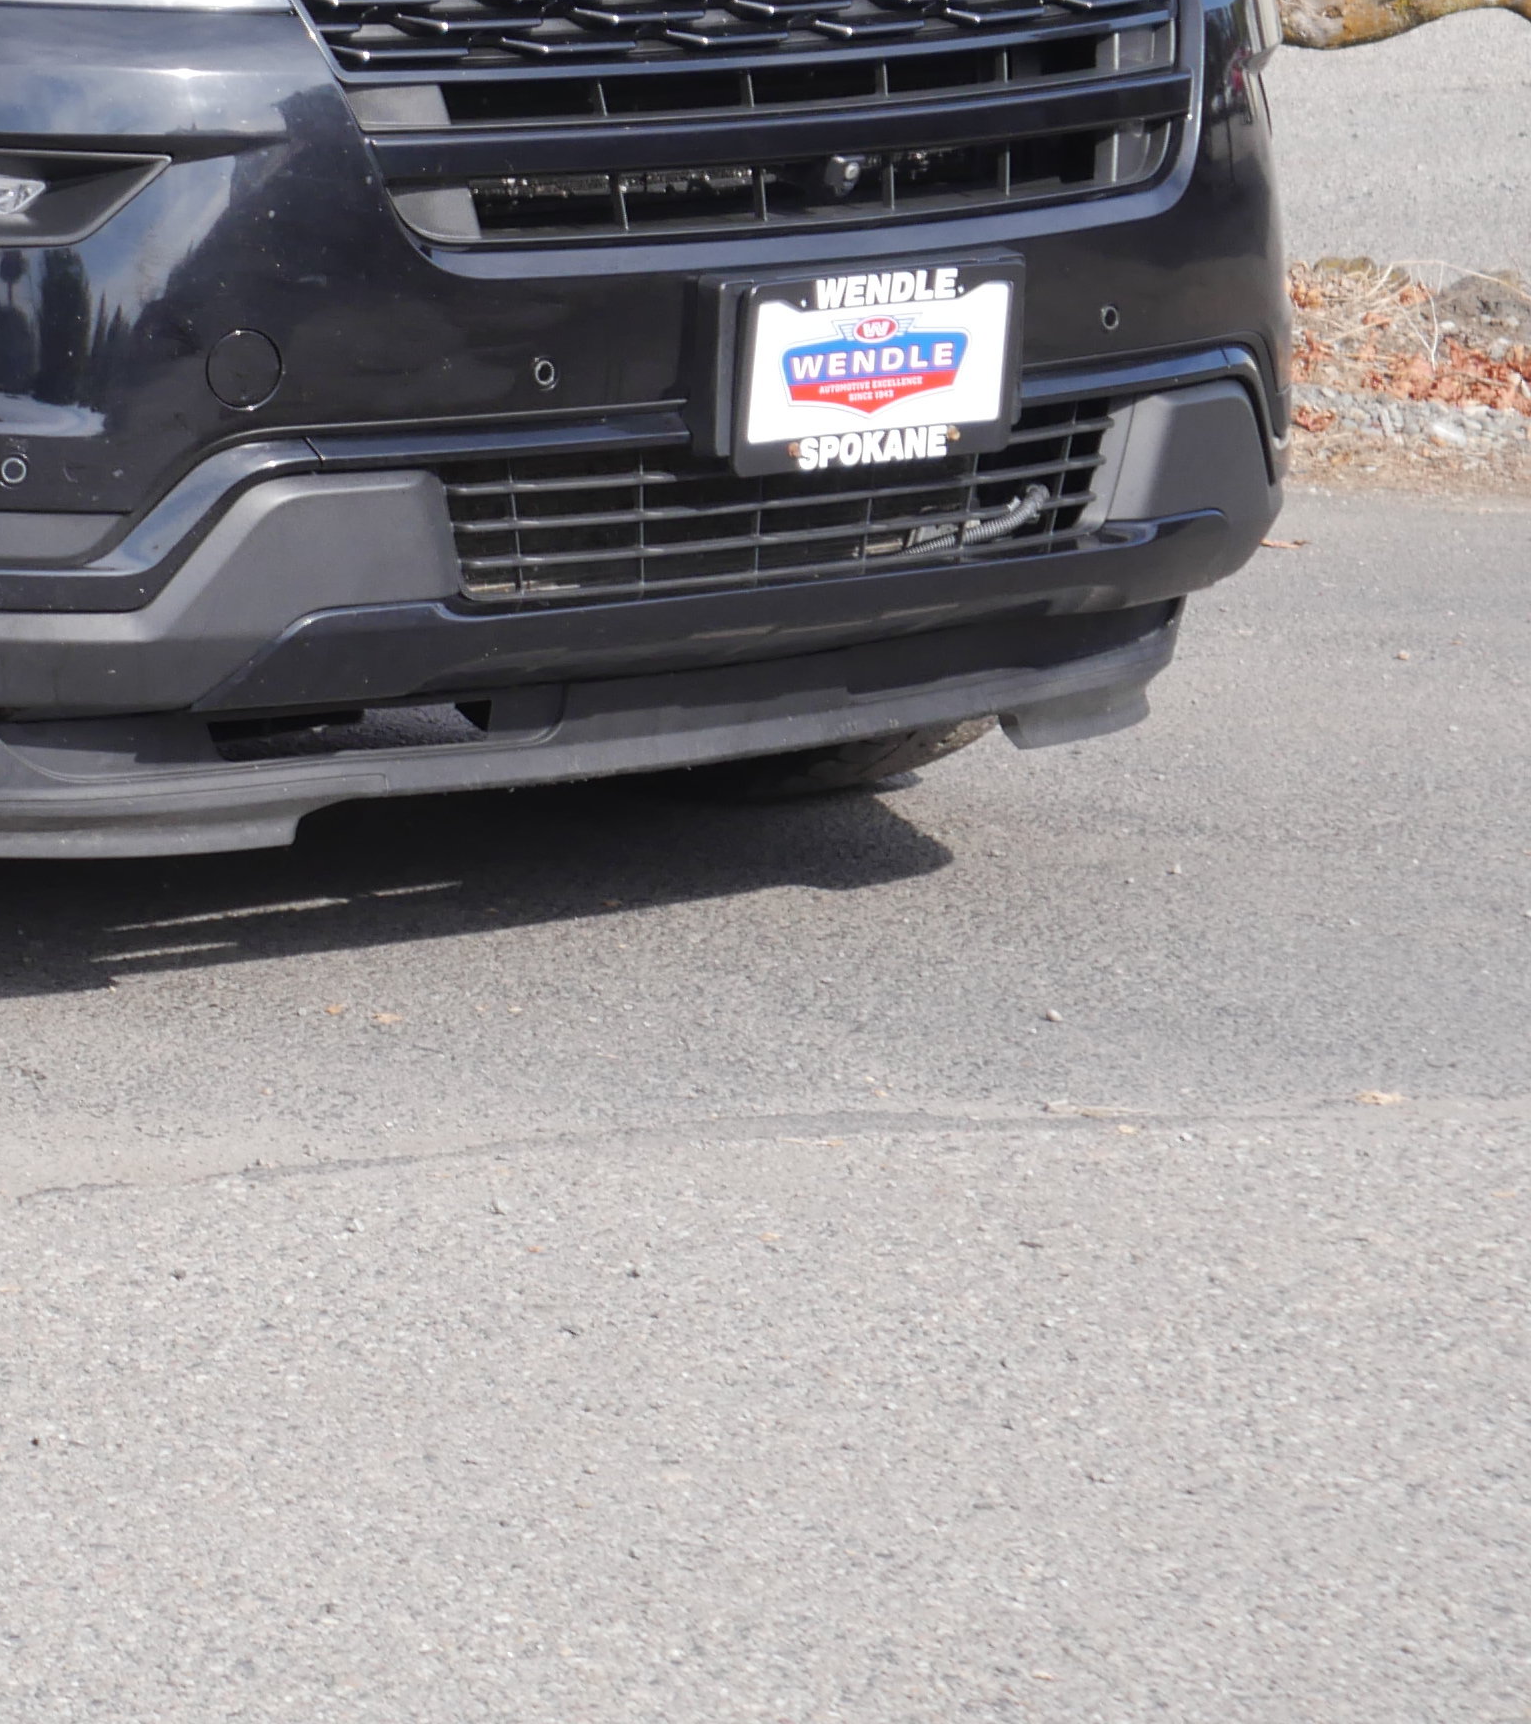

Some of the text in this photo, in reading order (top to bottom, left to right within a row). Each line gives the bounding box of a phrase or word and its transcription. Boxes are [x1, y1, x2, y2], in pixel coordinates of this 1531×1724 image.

[816, 267, 958, 310] WENDLE
[791, 342, 954, 380] WENDLE
[819, 376, 923, 394] AUTOMOTIVE EXCELLENCE
[848, 391, 873, 402] SINCE
[798, 425, 948, 471] SPOKANE
